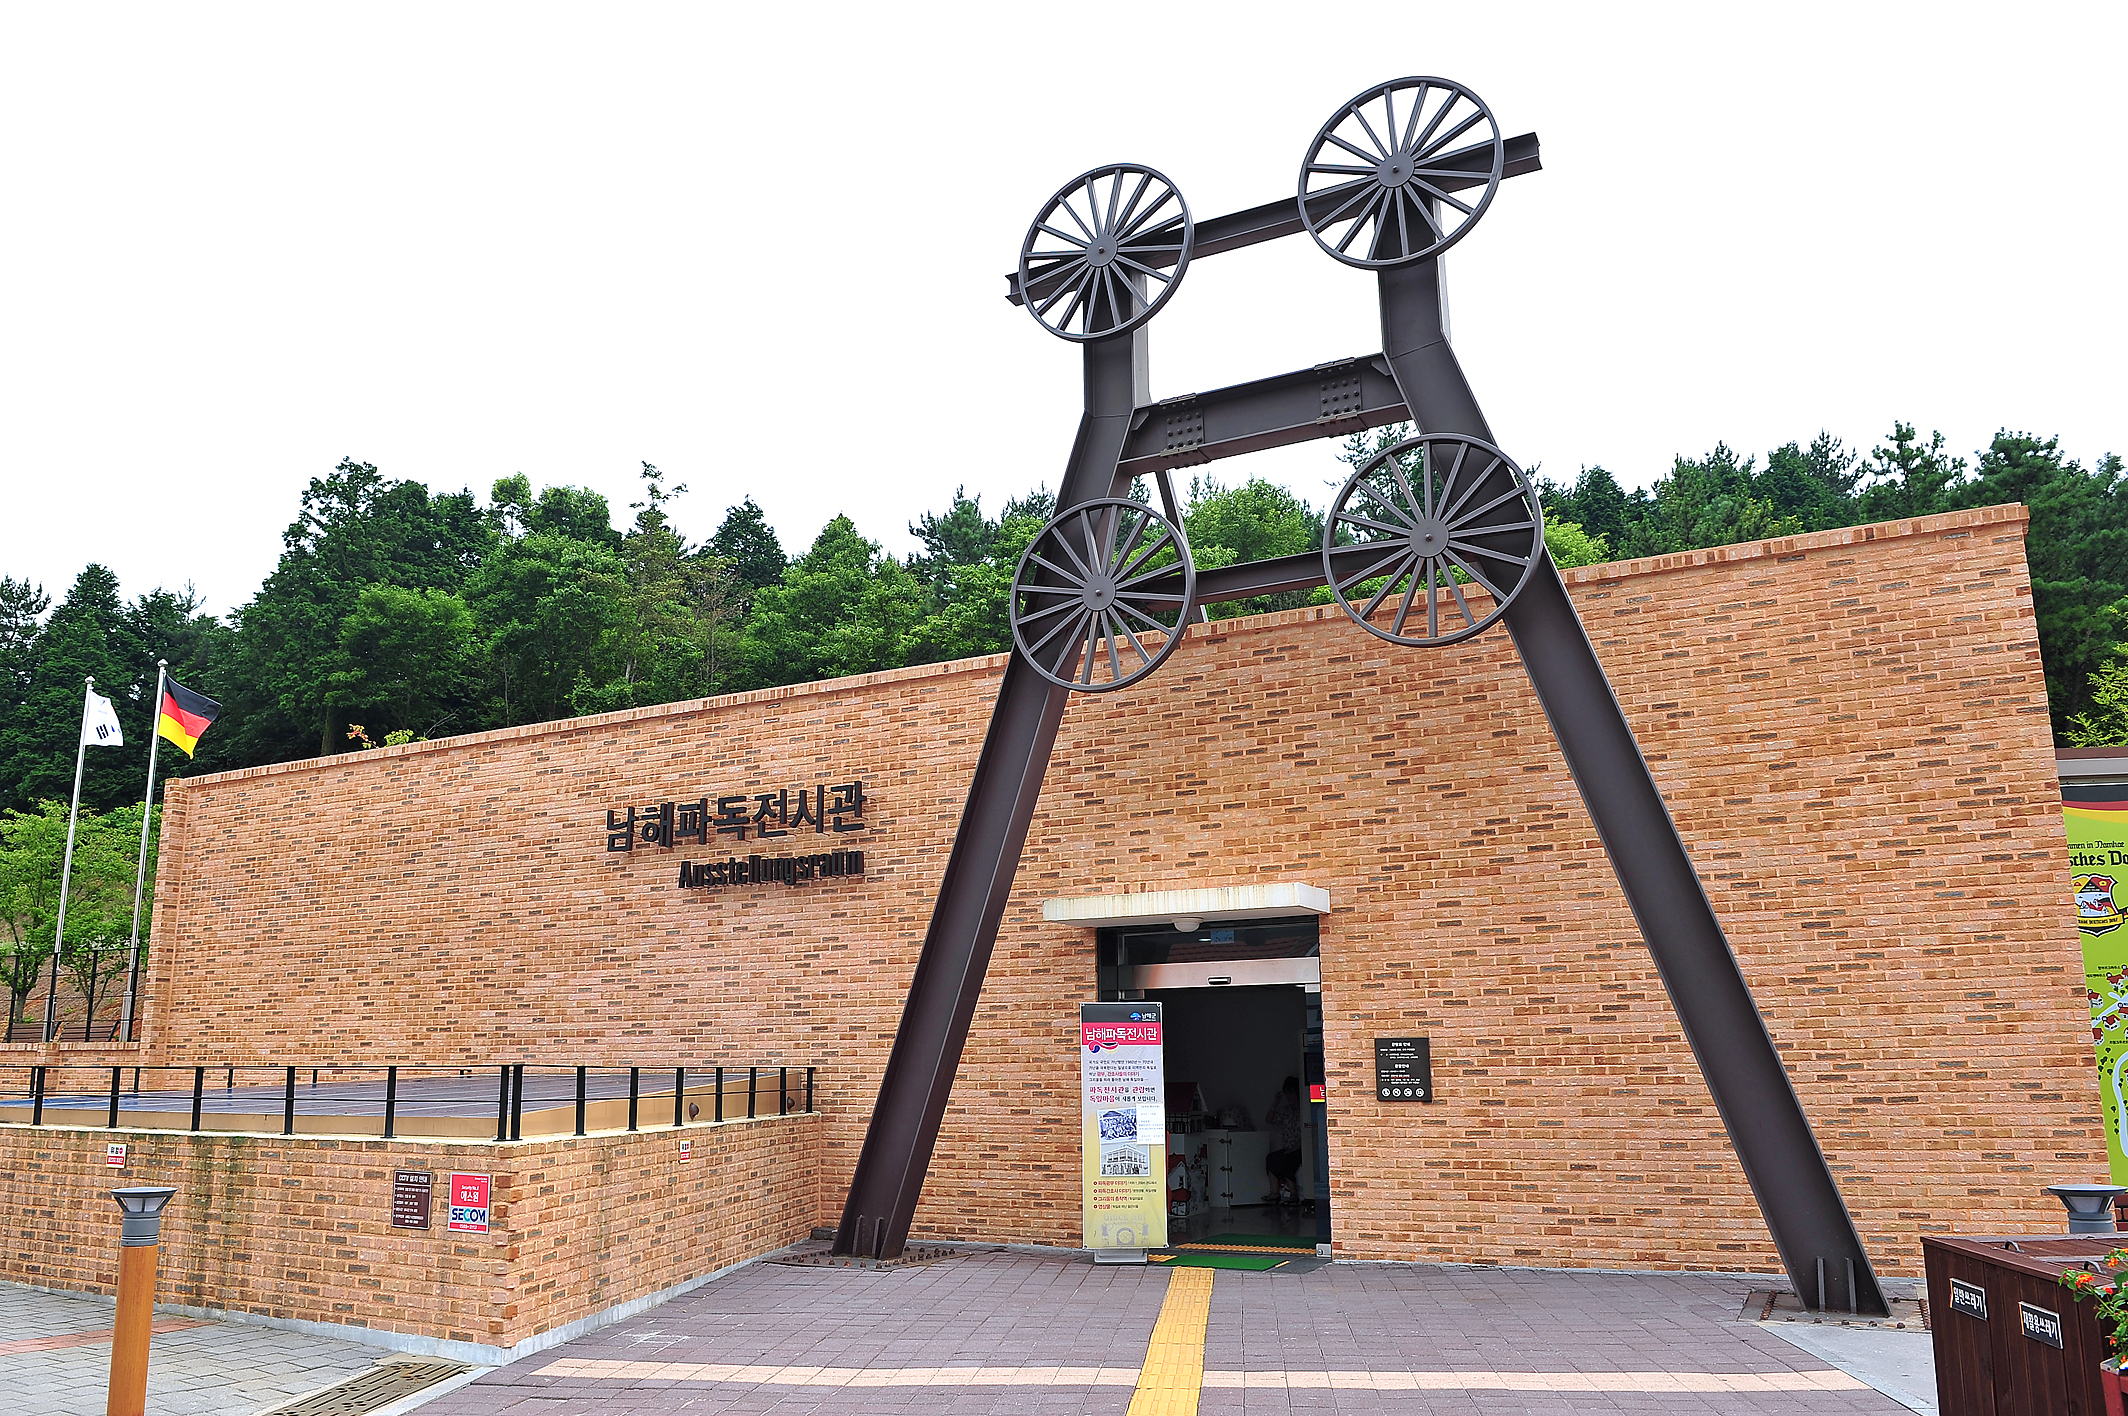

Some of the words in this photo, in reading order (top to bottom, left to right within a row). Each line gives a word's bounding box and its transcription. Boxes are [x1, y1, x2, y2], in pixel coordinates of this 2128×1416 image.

[606, 781, 867, 851] 남해파독전시관
[2095, 840, 2124, 849] Namhae
[678, 850, 865, 888] Ausstellungsraum
[1085, 1027, 1158, 1041] 남해파독전시관
[1089, 1086, 1129, 1094] 파독전시관을
[1132, 1086, 1156, 1094] 관람하면
[1089, 1095, 1120, 1103] 독일마을이
[460, 1191, 479, 1203] 에스원
[452, 1208, 486, 1223] SECOM
[1953, 1286, 1983, 1313] 일반쓰레기
[2022, 1310, 2059, 1340] 재활용쓰레기
